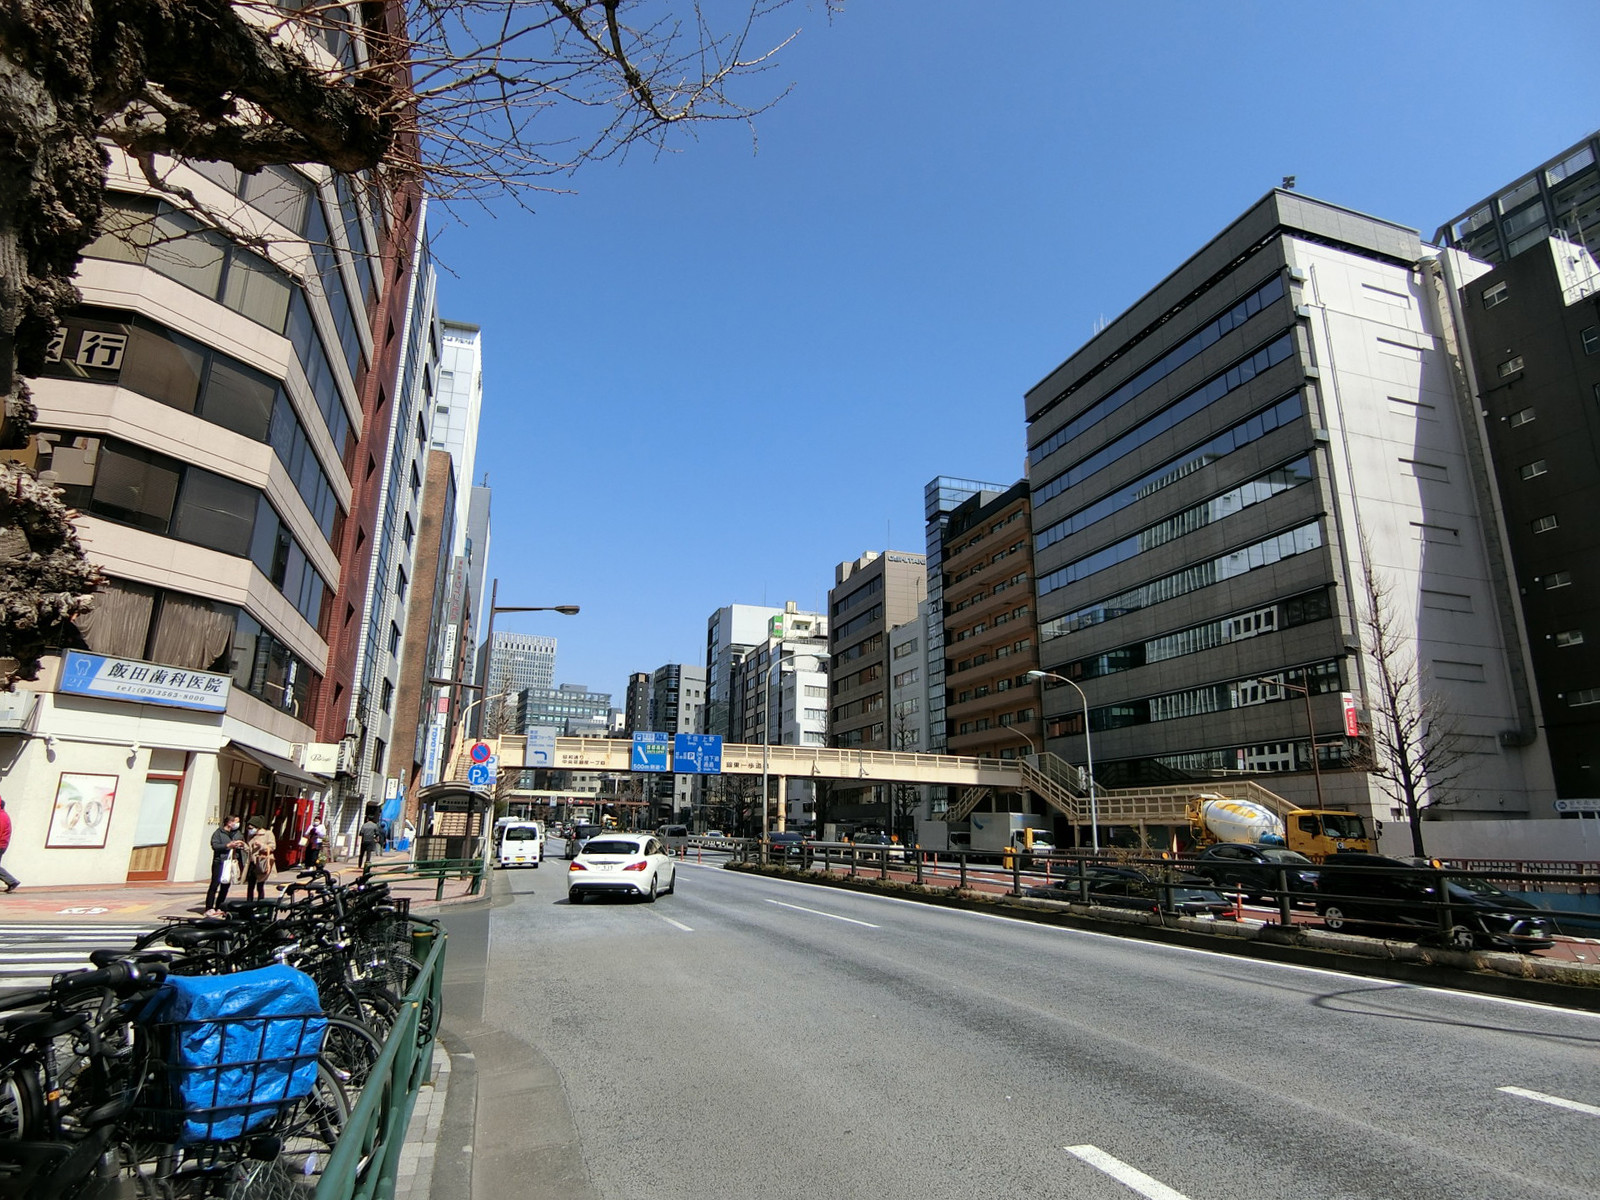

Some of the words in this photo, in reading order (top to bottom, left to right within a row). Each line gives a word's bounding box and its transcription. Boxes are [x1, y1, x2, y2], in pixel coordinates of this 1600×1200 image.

[107, 662, 223, 693] 飯田歯科医院
